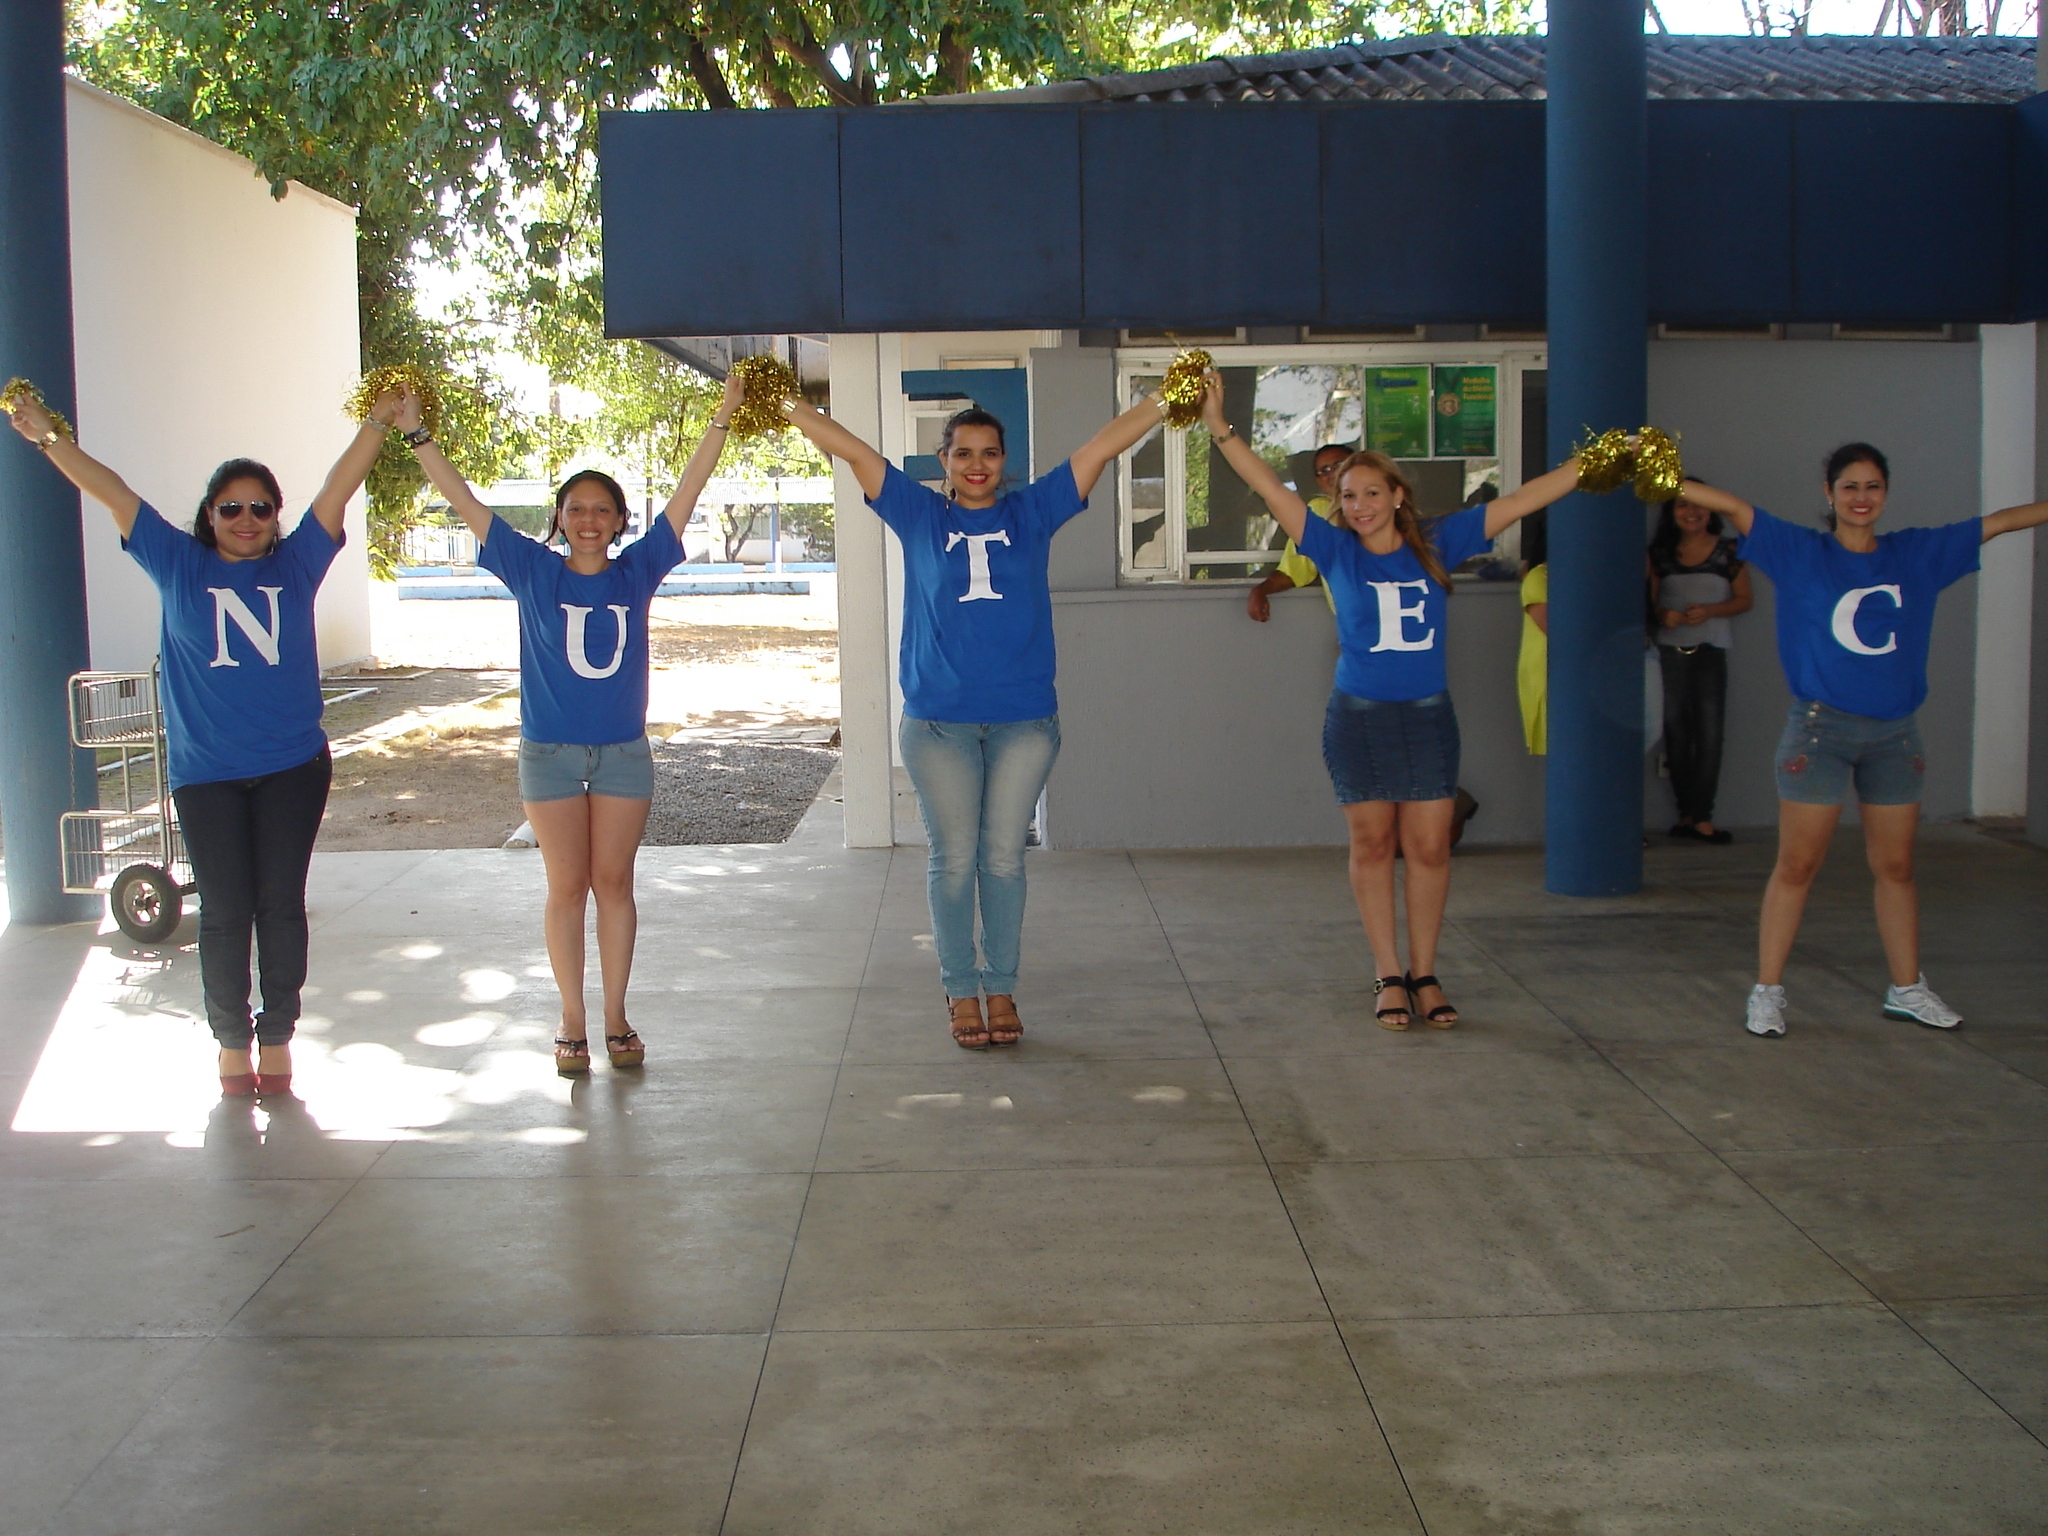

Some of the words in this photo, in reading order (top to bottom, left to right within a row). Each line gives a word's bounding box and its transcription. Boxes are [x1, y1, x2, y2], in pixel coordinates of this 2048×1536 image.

[945, 529, 1011, 603] T
[207, 586, 283, 668] N
[560, 603, 630, 679] U
[1367, 579, 1435, 653] E
[1832, 584, 1902, 655] C
